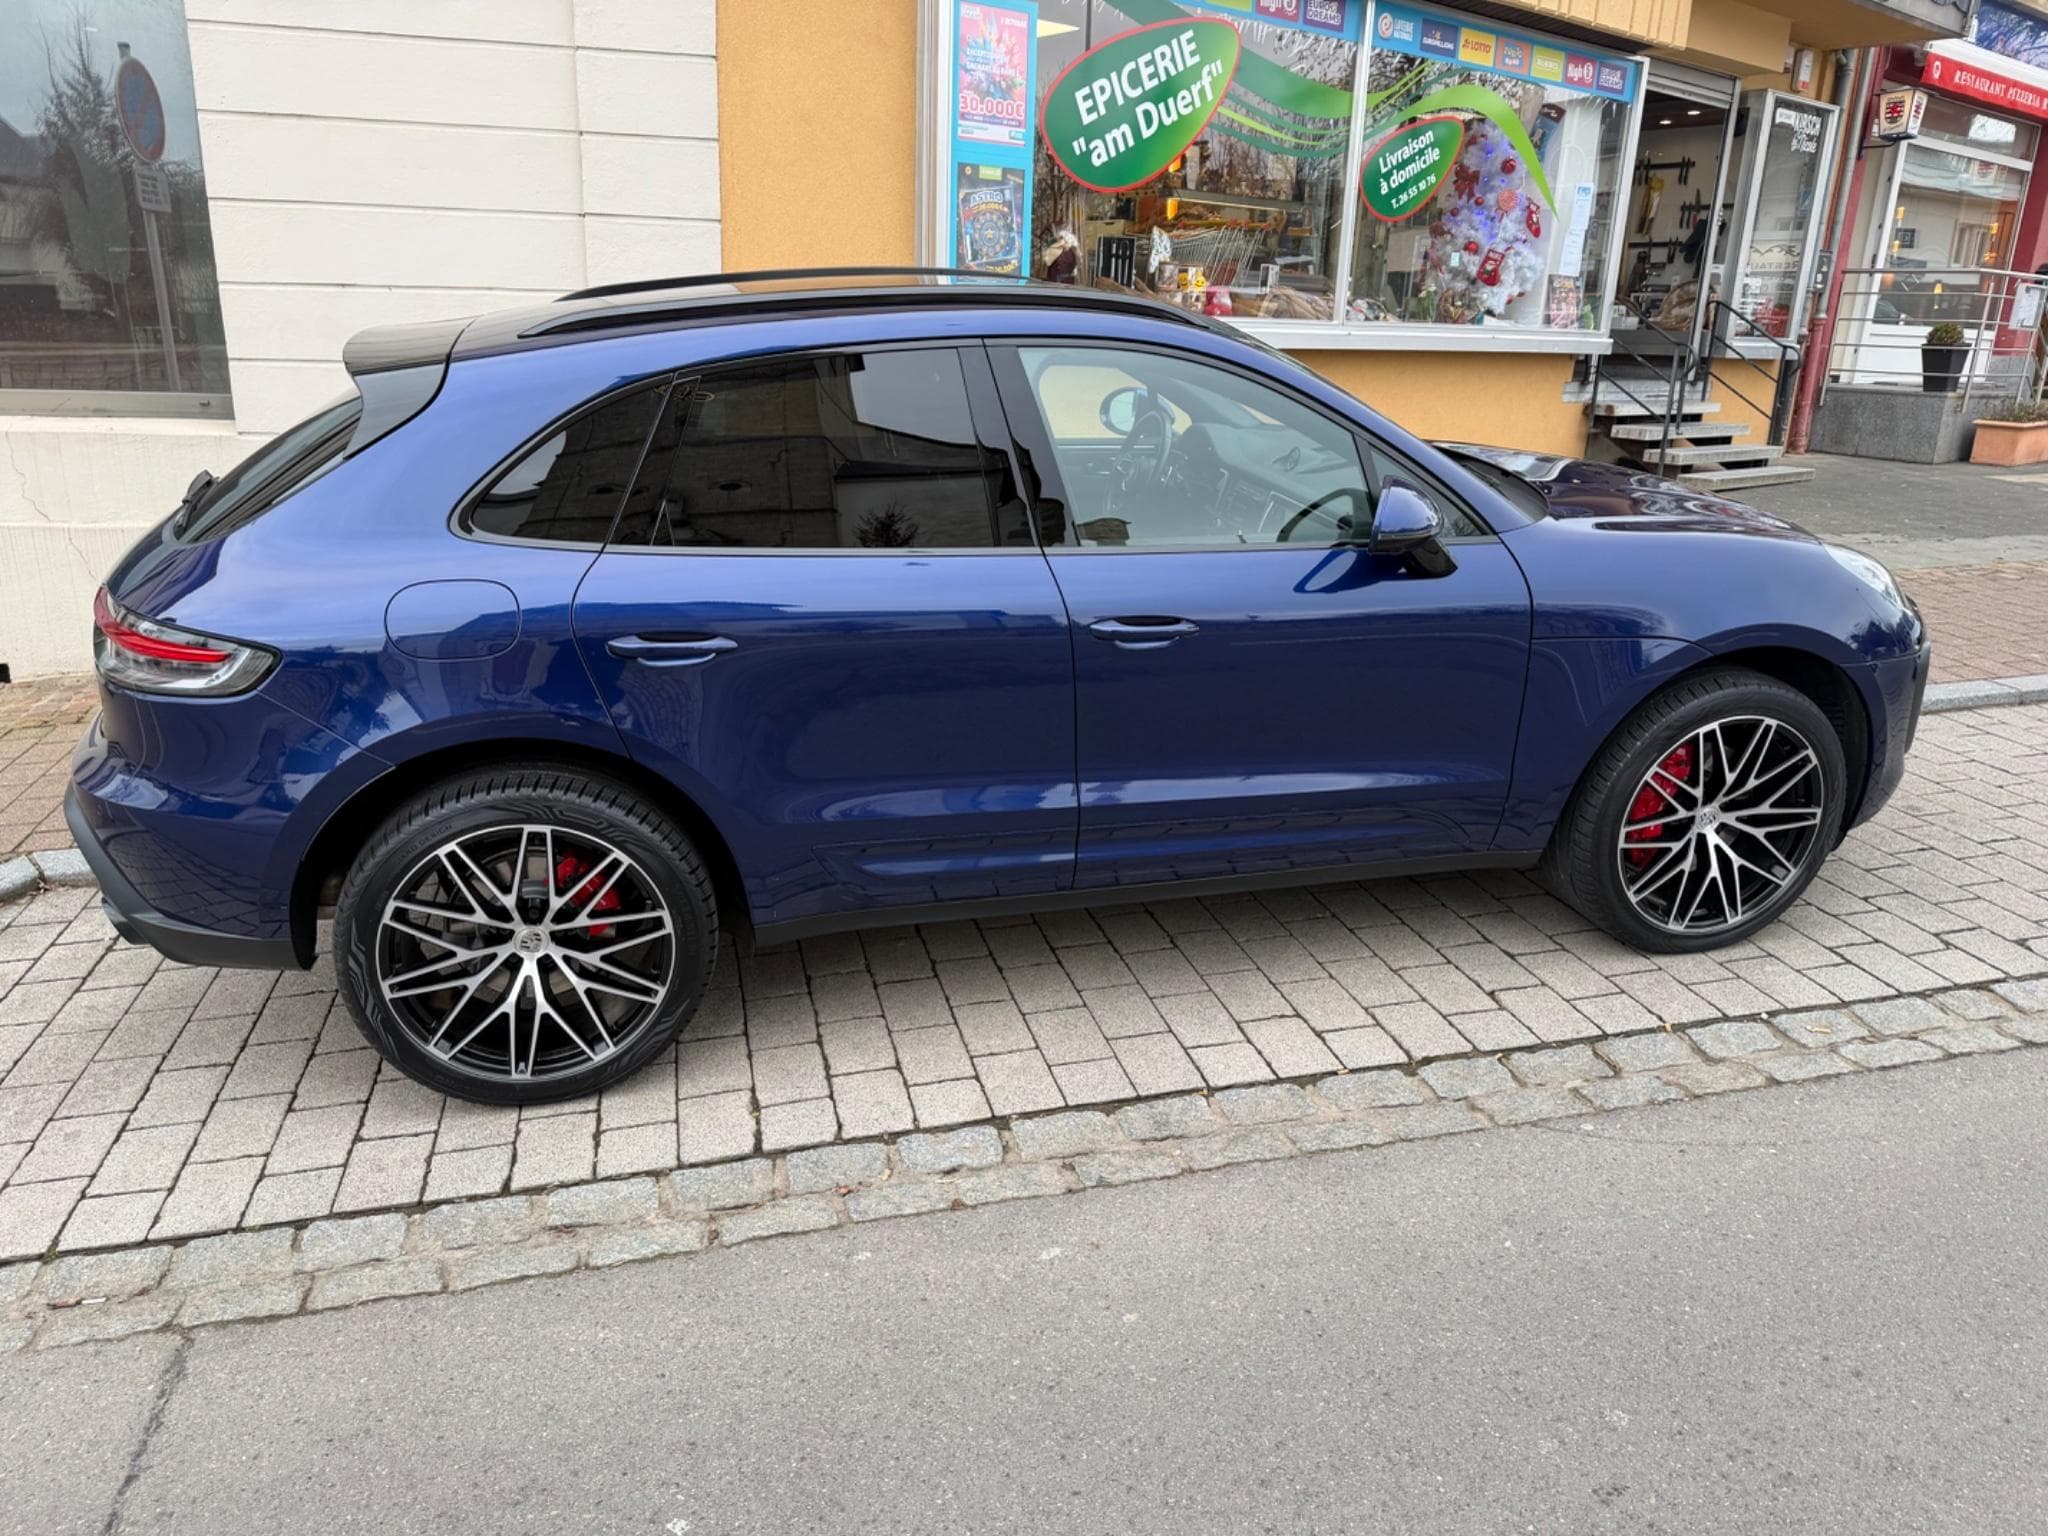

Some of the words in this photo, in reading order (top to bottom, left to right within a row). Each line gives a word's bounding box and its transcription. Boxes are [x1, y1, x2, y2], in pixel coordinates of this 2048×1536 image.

[1470, 41, 1492, 54] LOTTO
[1074, 29, 1201, 126] EPICERIE
[1954, 70, 2007, 97] RESTAURANT
[2007, 86, 2041, 107] PIZZERIA
[1072, 122, 1136, 167] "am
[1135, 59, 1223, 140] Duerf"
[1379, 130, 1434, 174] Livraison
[1380, 178, 1389, 195] à
[1389, 147, 1440, 188] domicile
[1408, 185, 1418, 199] 55
[1426, 173, 1437, 186] 76
